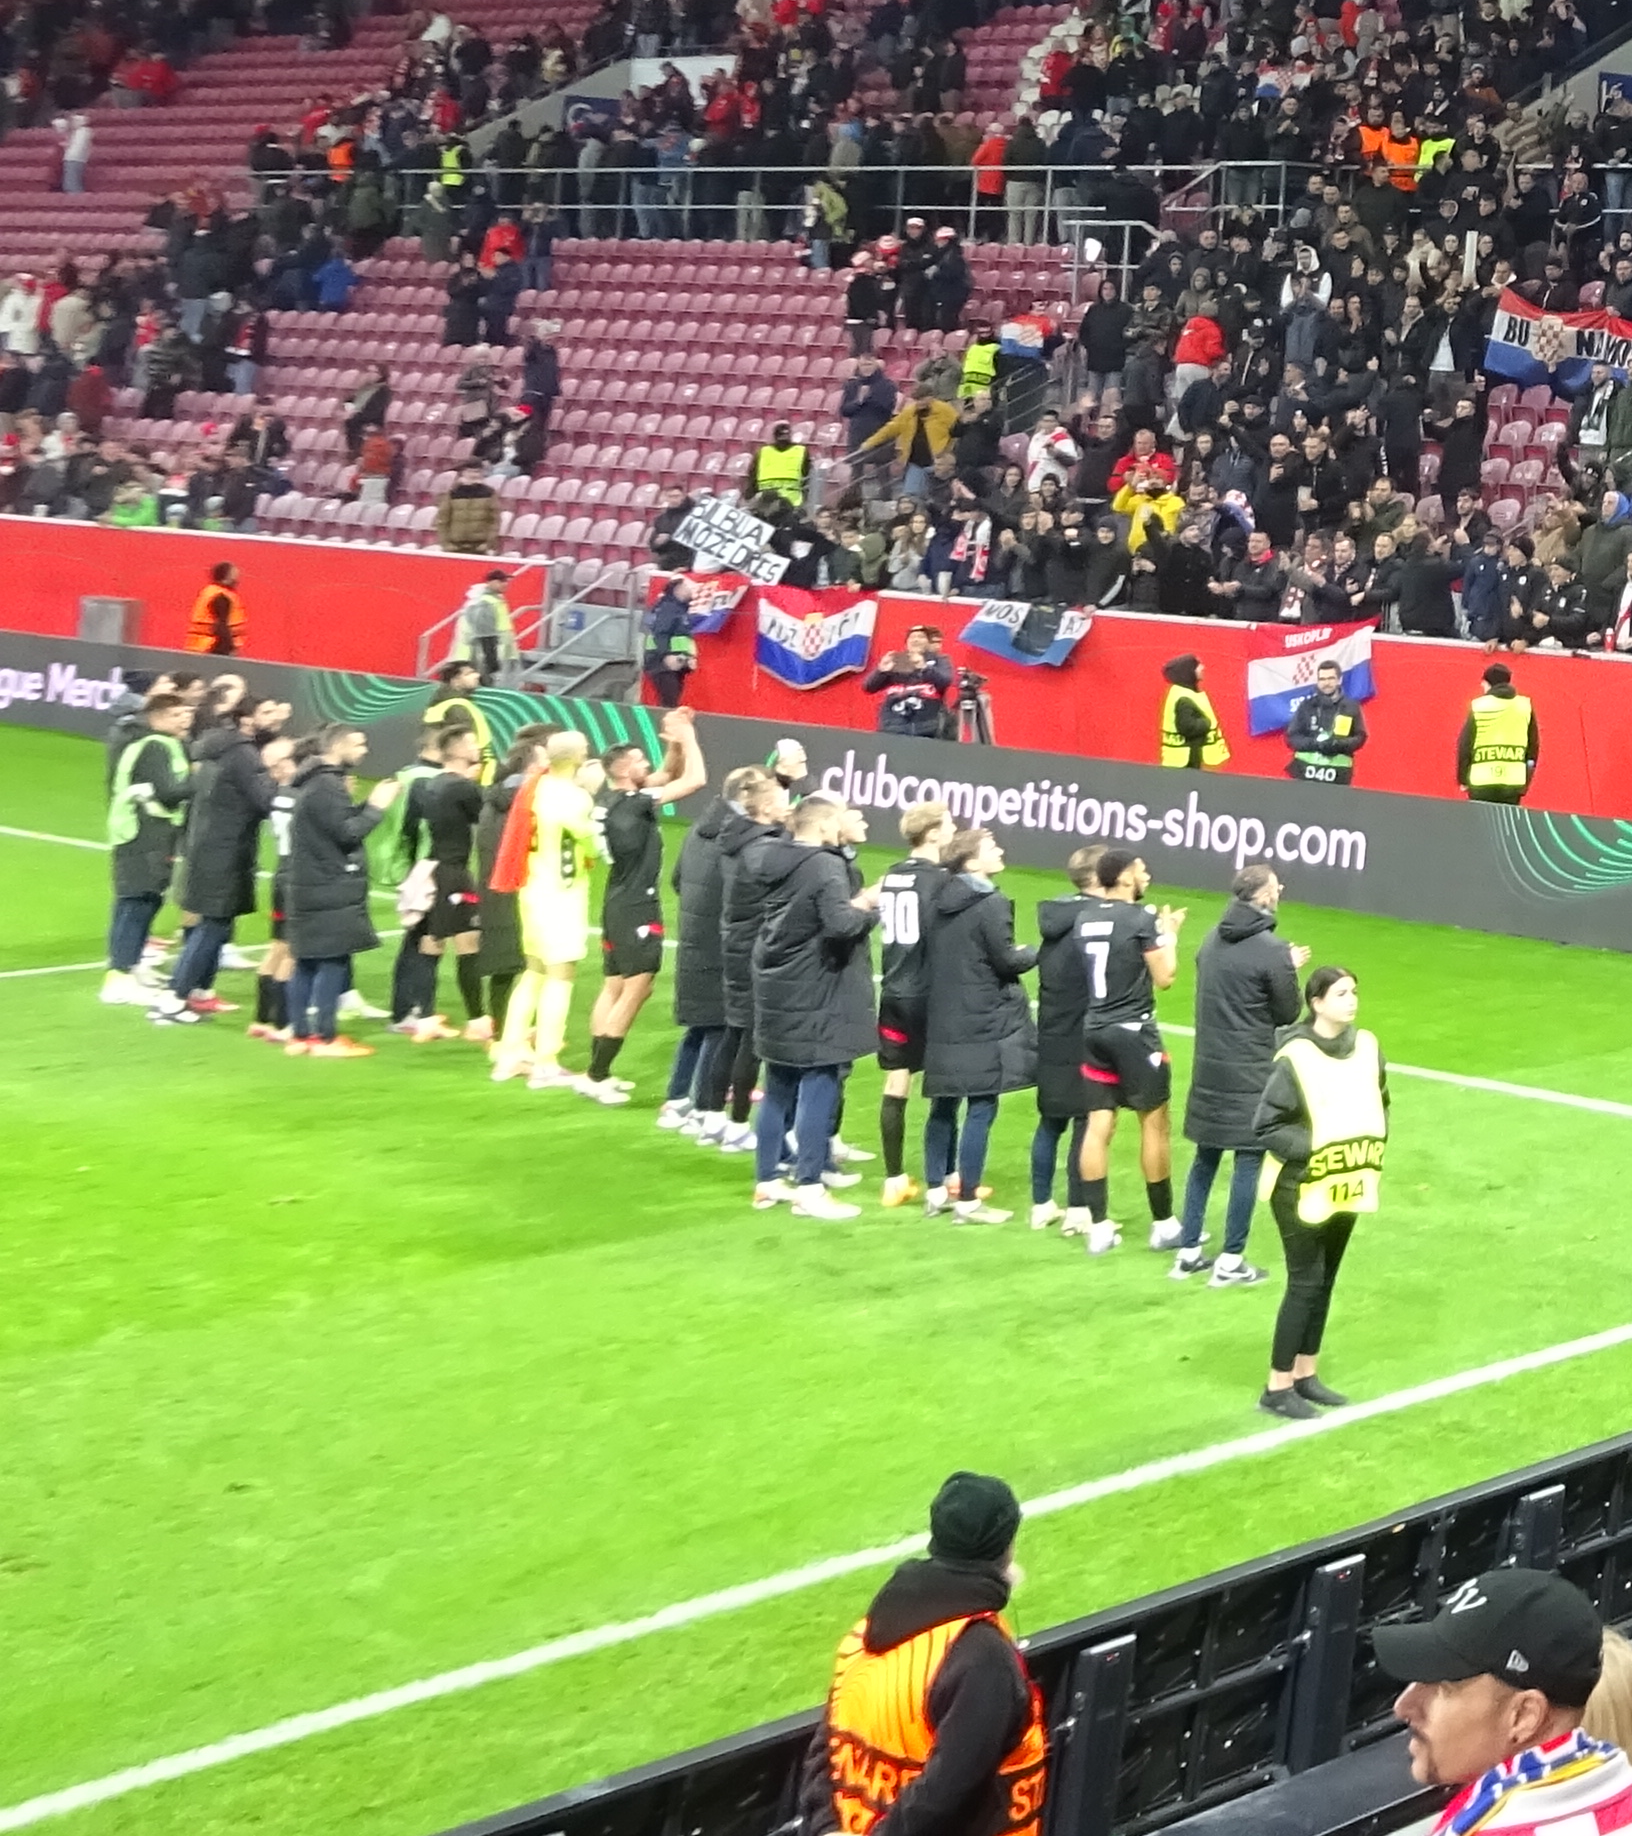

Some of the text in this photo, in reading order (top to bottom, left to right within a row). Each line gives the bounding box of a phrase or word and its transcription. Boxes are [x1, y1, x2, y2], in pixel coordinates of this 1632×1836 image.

[1474, 746, 1525, 762] STEWAR
[820, 750, 1367, 870] clubcompetitions-shop.com
[1085, 941, 1110, 999] 7
[1329, 1179, 1364, 1202] 114
